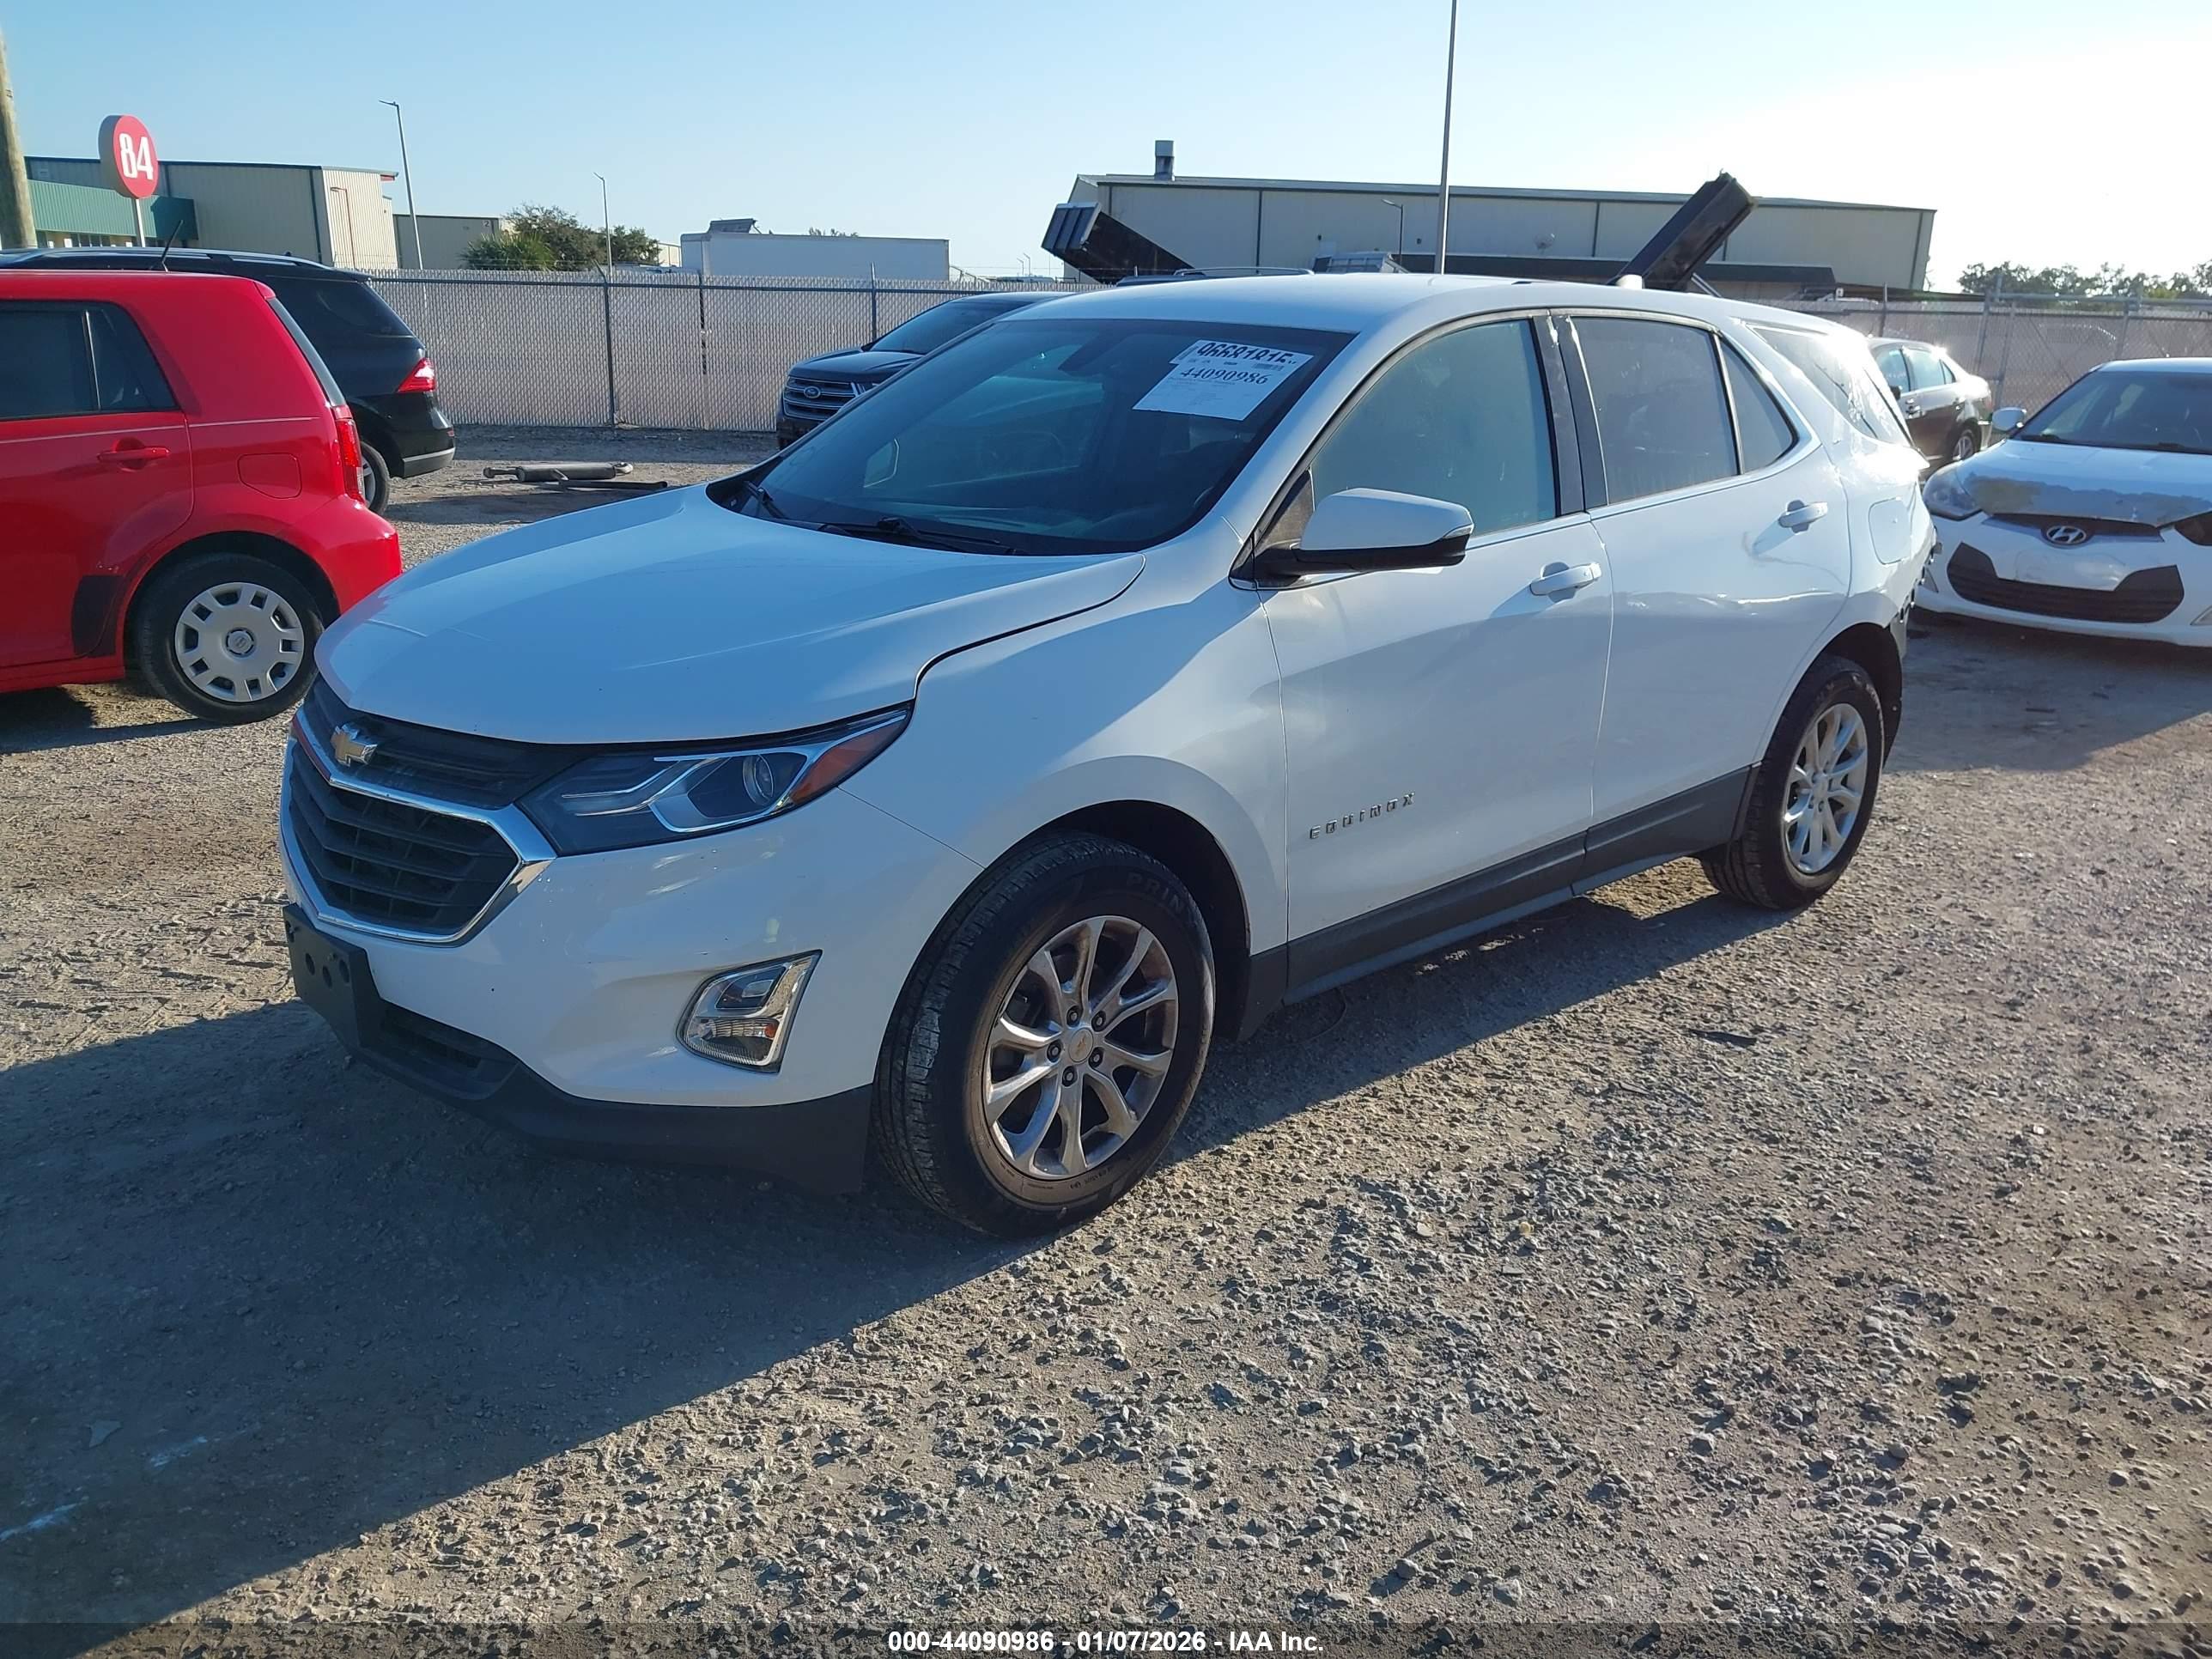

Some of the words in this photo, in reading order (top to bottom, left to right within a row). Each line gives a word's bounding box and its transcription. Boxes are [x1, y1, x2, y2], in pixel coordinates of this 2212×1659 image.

[118, 132, 154, 179] 84
[1181, 368, 1272, 385] 44090986
[1310, 792, 1415, 840] EQUINOX
